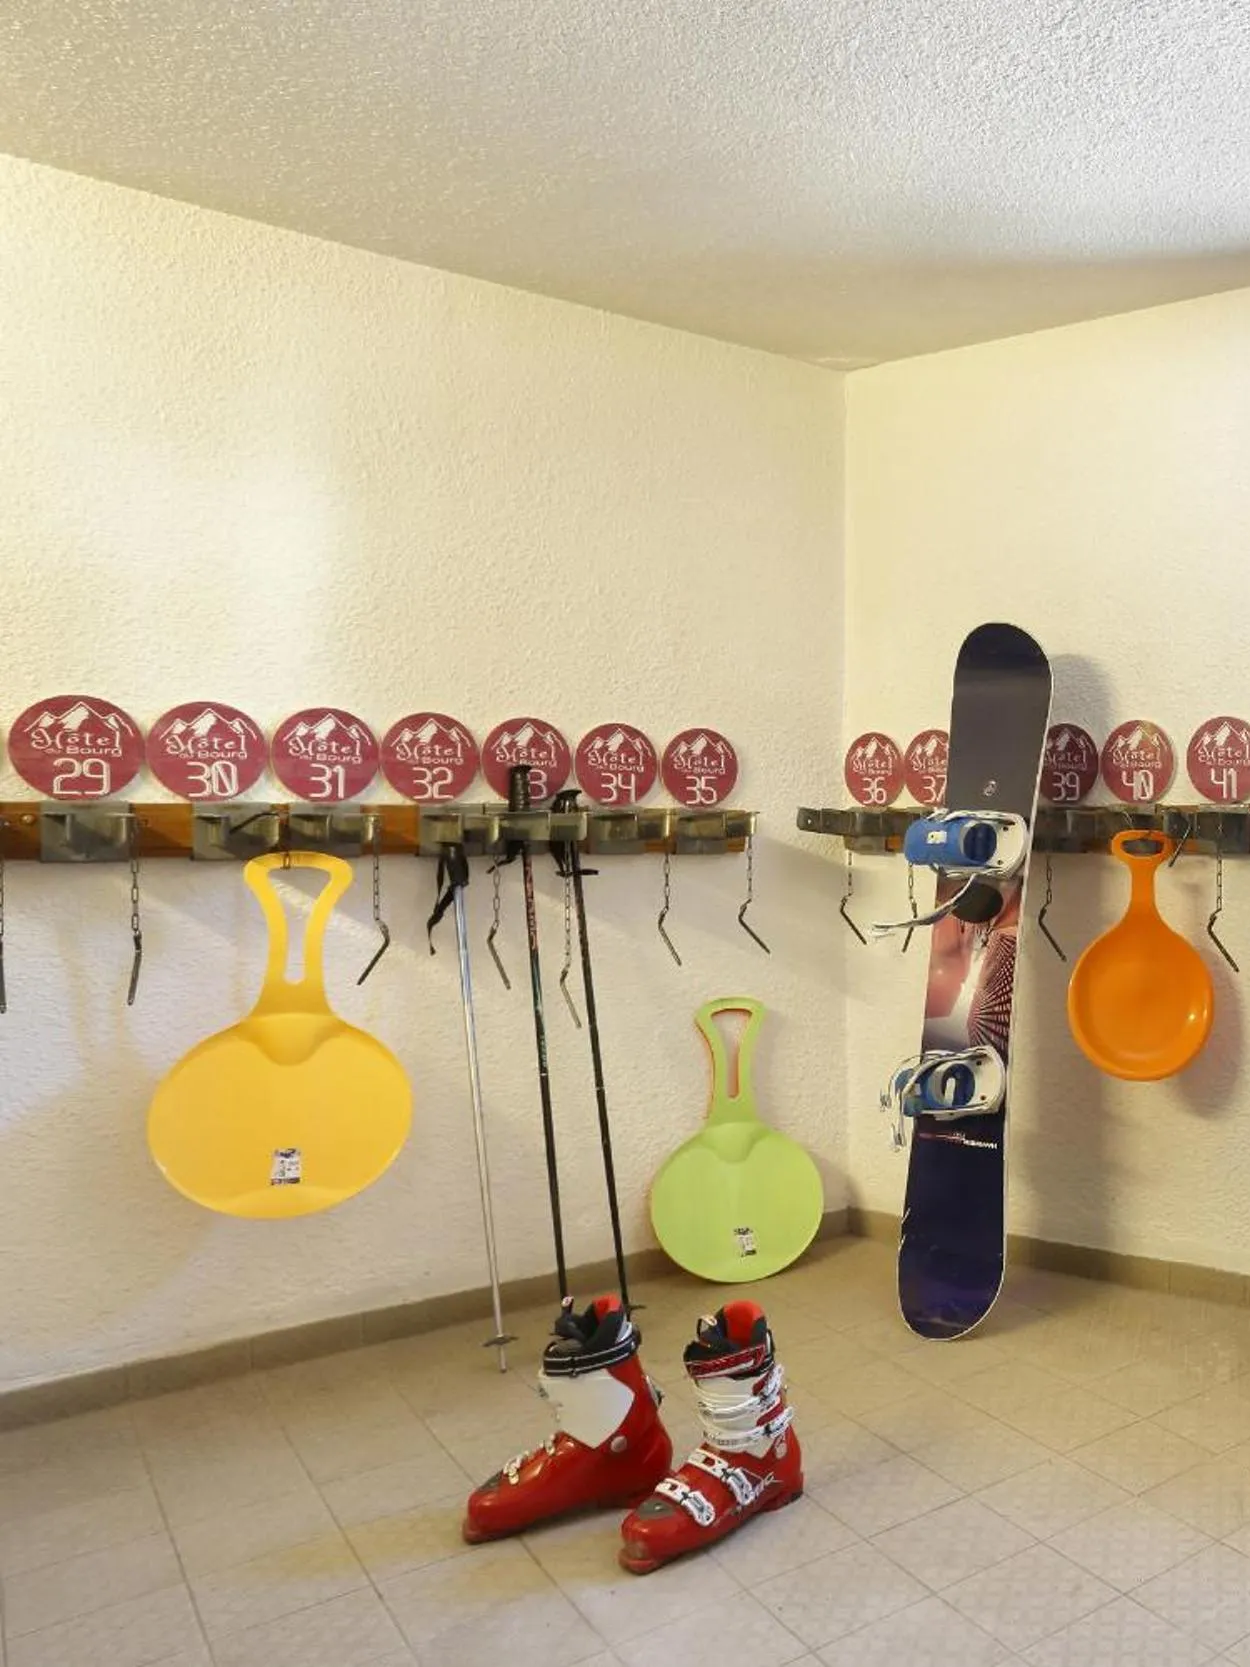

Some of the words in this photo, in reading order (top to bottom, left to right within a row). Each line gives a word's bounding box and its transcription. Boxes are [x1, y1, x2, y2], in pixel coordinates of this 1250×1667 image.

[66, 746, 122, 758] Bourg
[198, 750, 247, 759] Bourg
[316, 753, 362, 764] Bourg
[422, 756, 464, 766] Bourg
[1130, 760, 1162, 769] Bourg
[53, 758, 110, 795] 29
[187, 760, 239, 797] 30
[308, 763, 345, 799] 31
[412, 766, 454, 799] 32
[609, 763, 644, 773] Bourg
[693, 767, 726, 775] Bourg
[601, 773, 636, 803] 34
[686, 776, 717, 805] 35
[862, 776, 887, 804] 36
[922, 774, 947, 803] 37
[1052, 772, 1080, 801] 39
[1121, 769, 1154, 801] 40
[1210, 768, 1237, 799] 41
